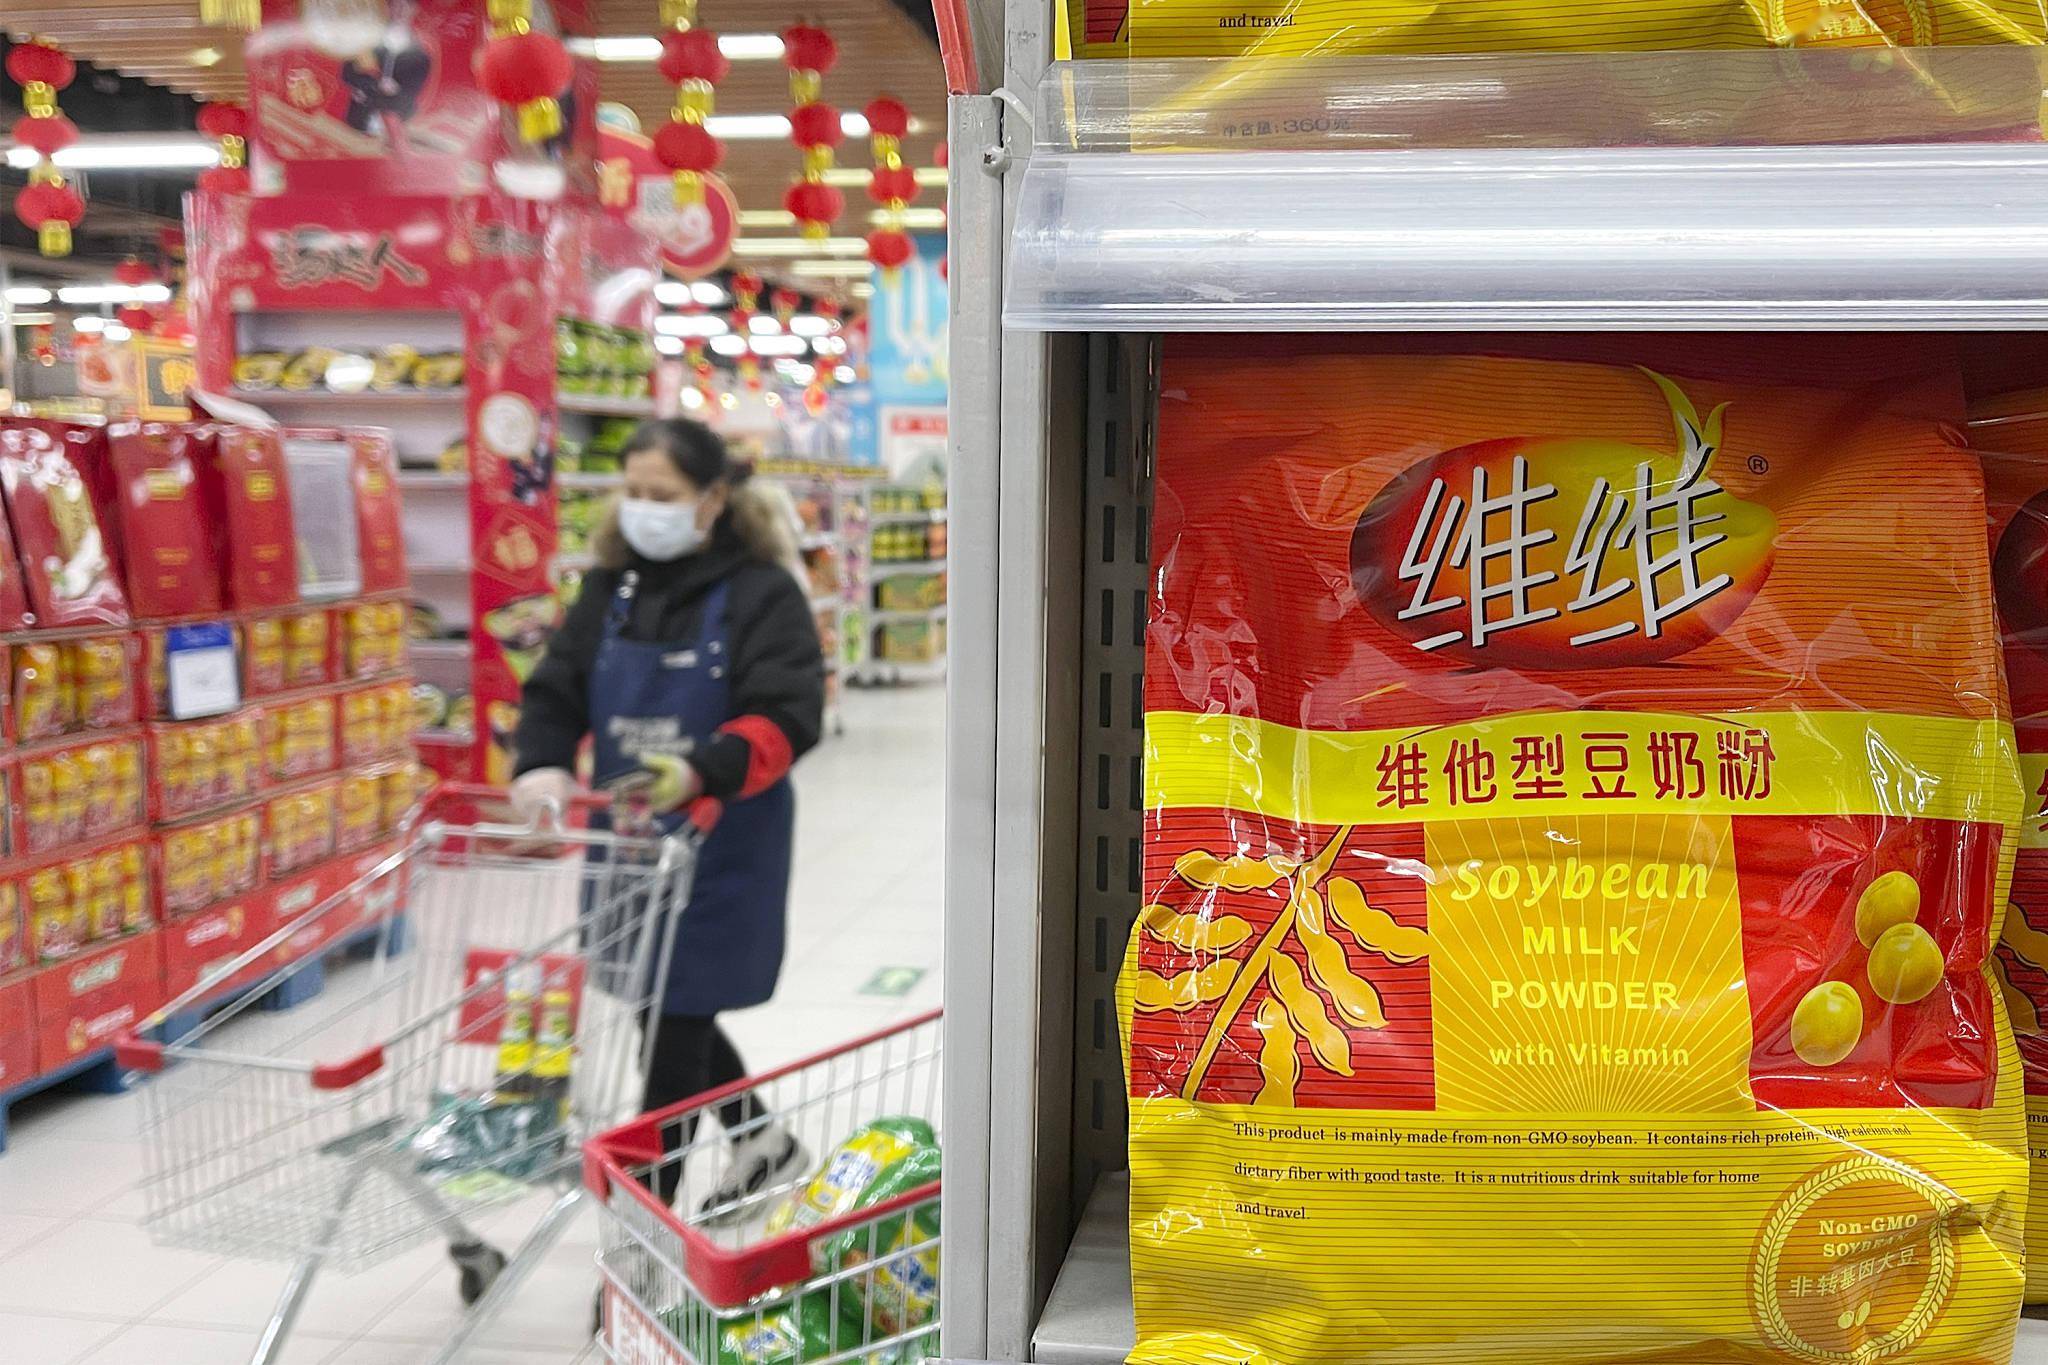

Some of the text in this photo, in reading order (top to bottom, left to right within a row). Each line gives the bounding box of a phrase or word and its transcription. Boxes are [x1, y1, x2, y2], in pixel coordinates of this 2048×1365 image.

[1219, 14, 1246, 28] and
[1398, 444, 1734, 650] 维维
[1376, 729, 1776, 810] 维他型豆奶粉
[1451, 856, 1708, 907] Soybean
[1522, 926, 1640, 955] MILK
[1490, 980, 1681, 1010] POWDER
[1489, 1042, 1690, 1066] with Vitamin
[1233, 1122, 1264, 1138] This
[1268, 1126, 1325, 1142] product
[1334, 1127, 1346, 1141] is
[1351, 1128, 1401, 1146] mainly
[1407, 1128, 1447, 1144] made
[1452, 1130, 1488, 1144] from
[1493, 1133, 1521, 1144] non
[1528, 1132, 1568, 1145] GMO
[1572, 1131, 1637, 1148] soybean.
[1647, 1131, 1660, 1145] It
[1664, 1131, 1727, 1145] contains
[1731, 1129, 1761, 1144] rich
[1764, 1127, 1819, 1146] protein,
[1824, 1123, 1851, 1141] high
[1851, 1123, 1891, 1137] calcium
[1233, 1162, 1760, 1184] dietary fiber with good taste. It is a nutritious drink suitable for home
[1235, 1202, 1310, 1220] and travel.
[1818, 1214, 1918, 1235] Non-GMO
[1788, 1244, 1920, 1298] 非转基因大豆
